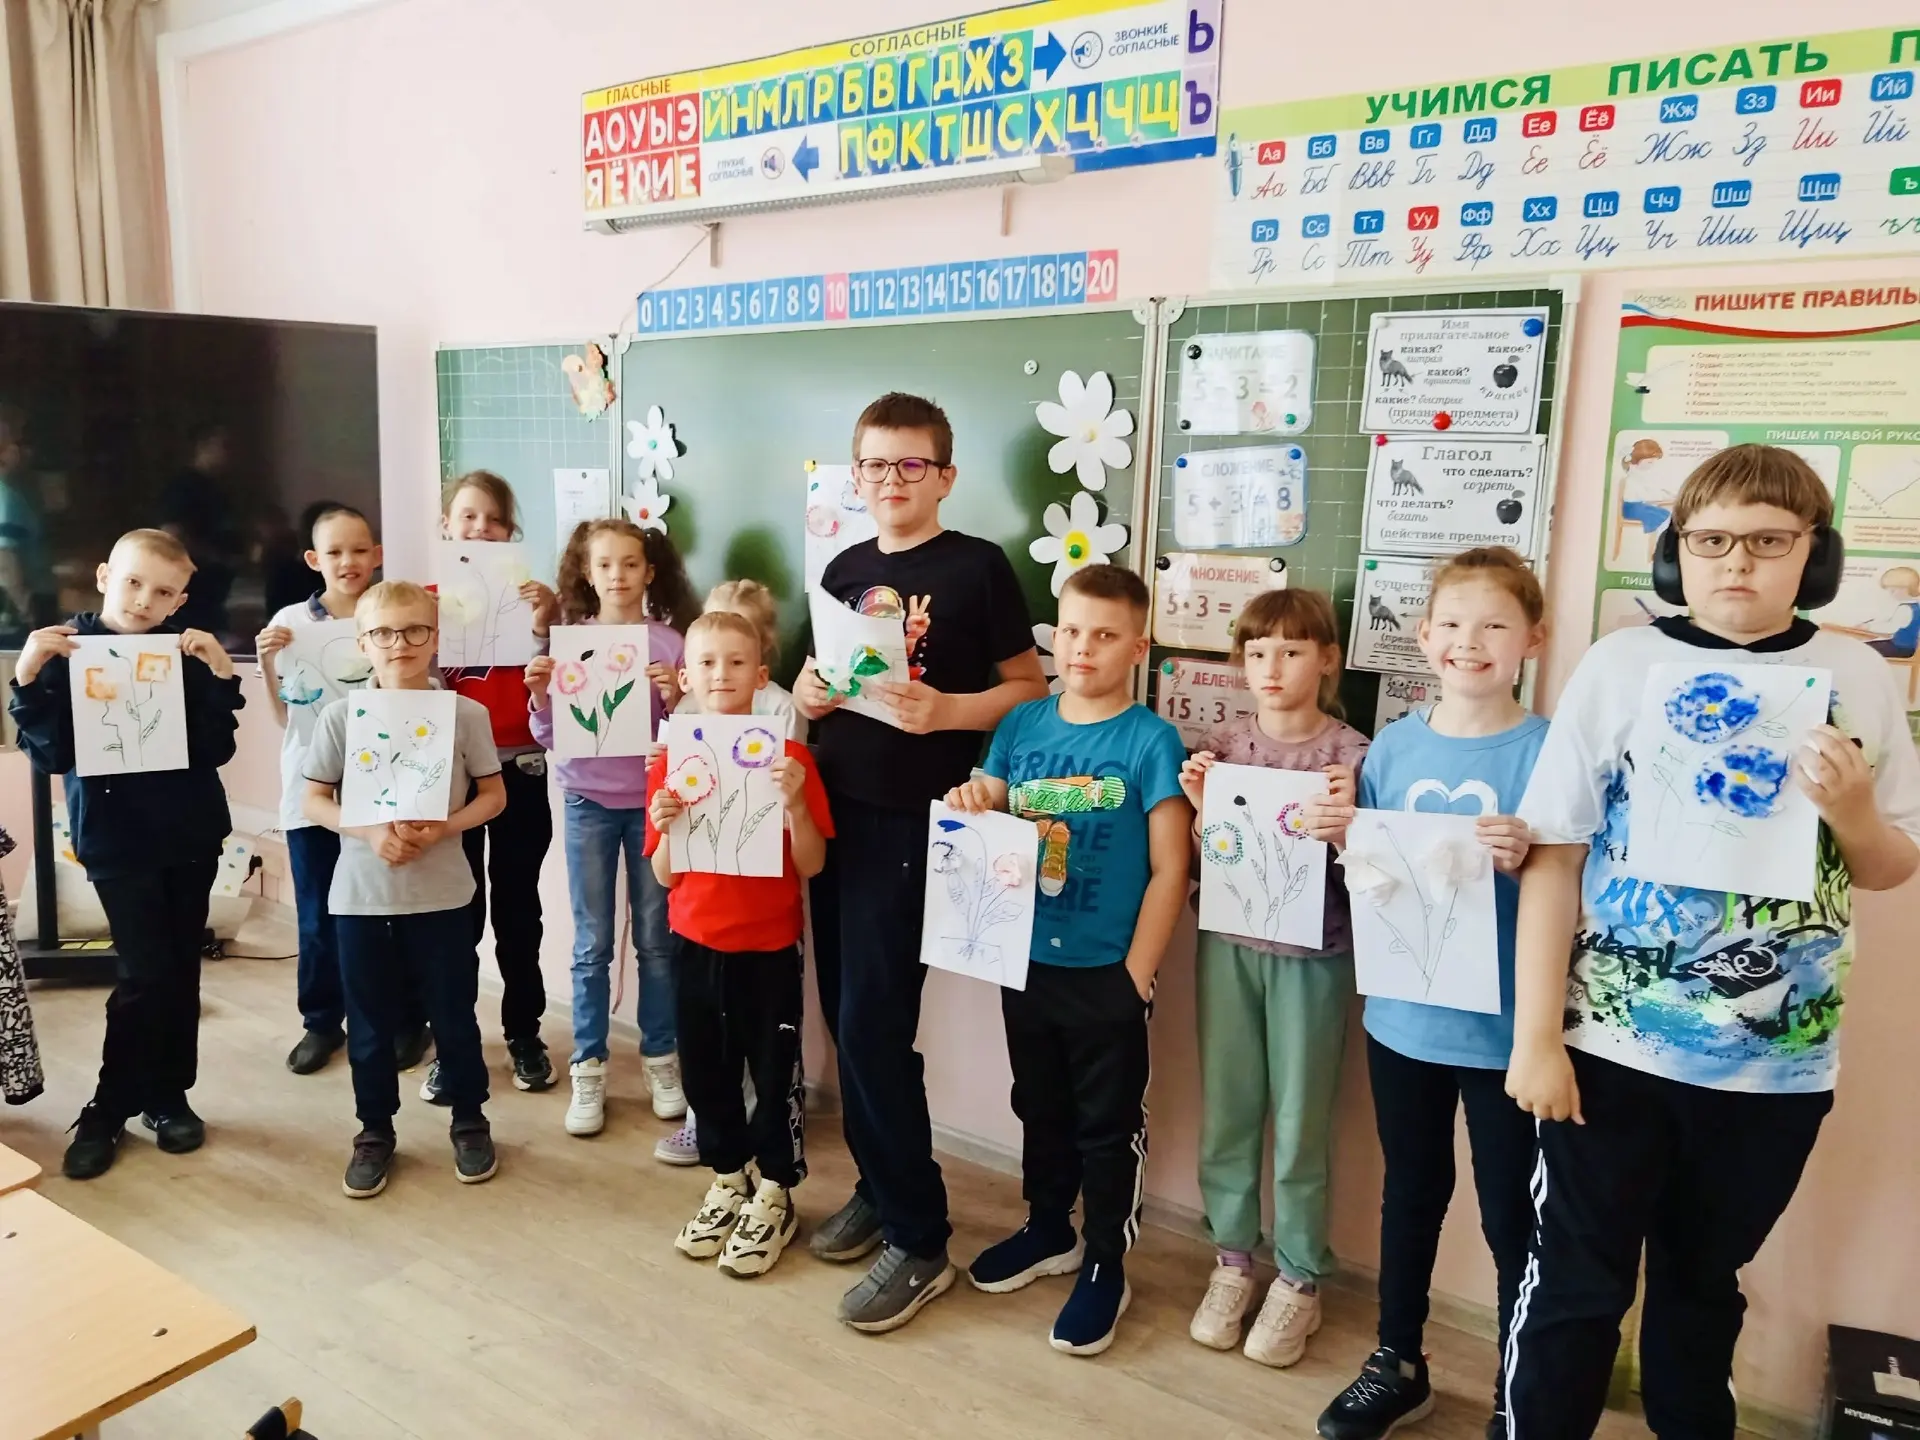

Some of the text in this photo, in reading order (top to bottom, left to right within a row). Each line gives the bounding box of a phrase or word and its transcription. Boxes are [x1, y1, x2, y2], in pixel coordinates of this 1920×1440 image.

[849, 22, 966, 58] СОГЛАСНЫЕ
[1114, 23, 1168, 41] ЗВОНКИЕ
[1188, 9, 1214, 54] Ь
[1108, 34, 1179, 57] СОГЛАСНЫЕ
[1364, 74, 1551, 123] УЧИМСЯ
[1608, 41, 1829, 96] ПИСАТЬ
[606, 78, 671, 105] ГЛАСНЫЕ
[1185, 80, 1212, 125] Ъ
[1261, 77, 1906, 162] Аа Бб Вв Гг Дд Ее Ёё Жж Зз Ии Йй
[1251, 171, 1287, 200] Аа
[1255, 224, 1275, 241] Рр
[1305, 219, 1326, 234] Сс
[1360, 215, 1378, 230] Тт
[1413, 213, 1434, 230] Уу
[1462, 207, 1492, 225] Фф
[1528, 202, 1552, 218] Хх
[1588, 198, 1614, 217] Цц
[1650, 193, 1675, 209] Чч
[1714, 188, 1749, 205] Шш
[1801, 181, 1839, 200] Щщ
[641, 258, 1115, 327] 0 1 2 3 4 5 6 7 8 9 10 11 12 13 14 15 16 17 18 19 20
[1694, 292, 1796, 312] ПИШИТЕ
[1802, 286, 1920, 308] ПРАВИЛЬ
[1441, 319, 1470, 329] Имя
[1400, 330, 1510, 342] прилагательное
[1400, 343, 1532, 354] какая? какое?
[1427, 366, 1470, 377] какой?
[1236, 375, 1250, 400] 3
[1283, 374, 1298, 399] 2
[1375, 395, 1417, 404] какие?
[1388, 407, 1519, 420] (призна предмета)
[1766, 429, 1920, 442] ПИШЕМ ПРАВОЙ РУКО
[1421, 445, 1492, 462] Глагол
[1201, 458, 1274, 477] СЛОЖЕНИЕ
[1442, 467, 1533, 479] что сделать?
[1463, 481, 1516, 494] созреть
[1276, 486, 1292, 511] 8
[1376, 498, 1454, 510] что делать?
[1387, 510, 1429, 522] бегать
[1380, 528, 1521, 545] (действие предмета)
[1190, 566, 1260, 583] МНОЖЕНИЕ
[1621, 576, 1652, 586] ПИШ
[1166, 592, 1209, 618] 5 3
[1167, 696, 1226, 723] 15 3
